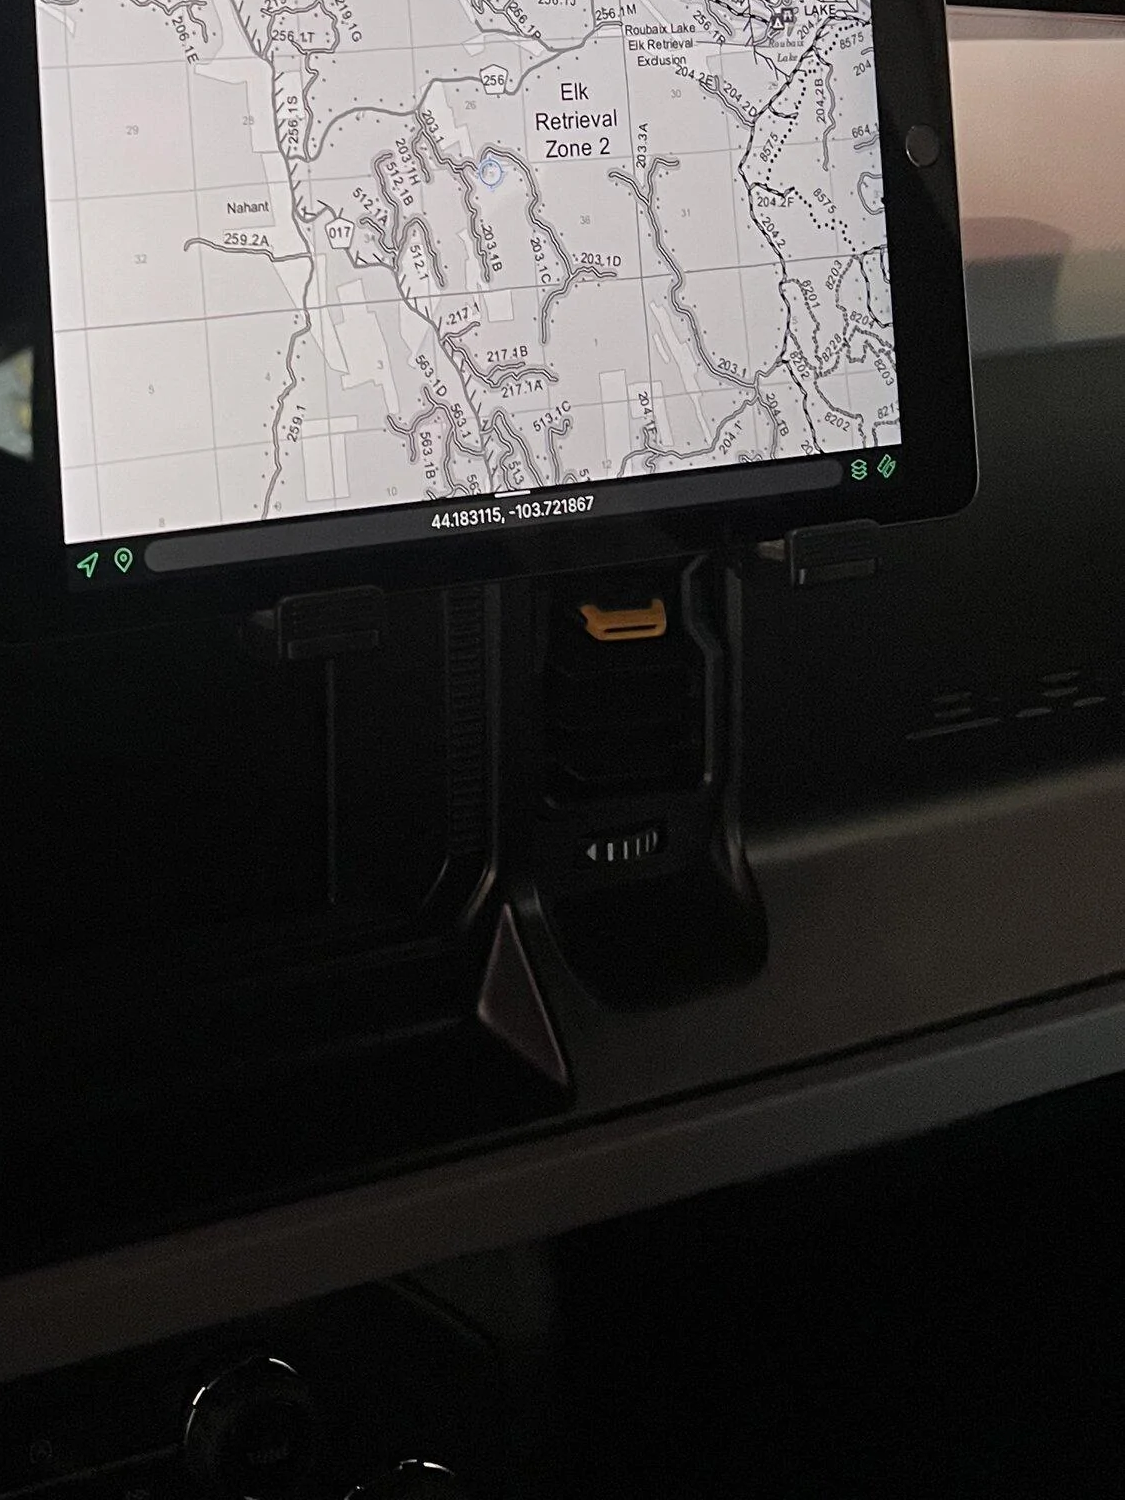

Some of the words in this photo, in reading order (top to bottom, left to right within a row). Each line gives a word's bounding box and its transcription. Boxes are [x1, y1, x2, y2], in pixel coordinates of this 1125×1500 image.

[804, 4, 836, 16] LAKE
[625, 24, 668, 36] Roubaix
[670, 21, 696, 34] Lake
[172, 16, 200, 65] 206.1E
[628, 40, 645, 51] Elk
[647, 38, 694, 50] Retrieval
[839, 31, 865, 50] 8575
[483, 74, 505, 87] 256
[561, 82, 590, 102] Elk
[535, 108, 618, 131] Retrieval
[545, 139, 592, 159] Zone
[599, 137, 611, 156] 2
[636, 122, 649, 169] 203.3A
[227, 201, 269, 215] Nahant
[223, 233, 270, 248] 259.2A
[329, 226, 352, 240] 017
[581, 252, 622, 268] 203.1D
[415, 354, 448, 397] 563.1D
[501, 379, 544, 399] 217.1A
[286, 404, 307, 444] 259.1
[450, 403, 472, 439] 563.1
[824, 411, 852, 433] 8202
[420, 431, 436, 480] 563.1B
[430, 506, 506, 529] 44.183115,
[508, 494, 595, 519] -103.721867
